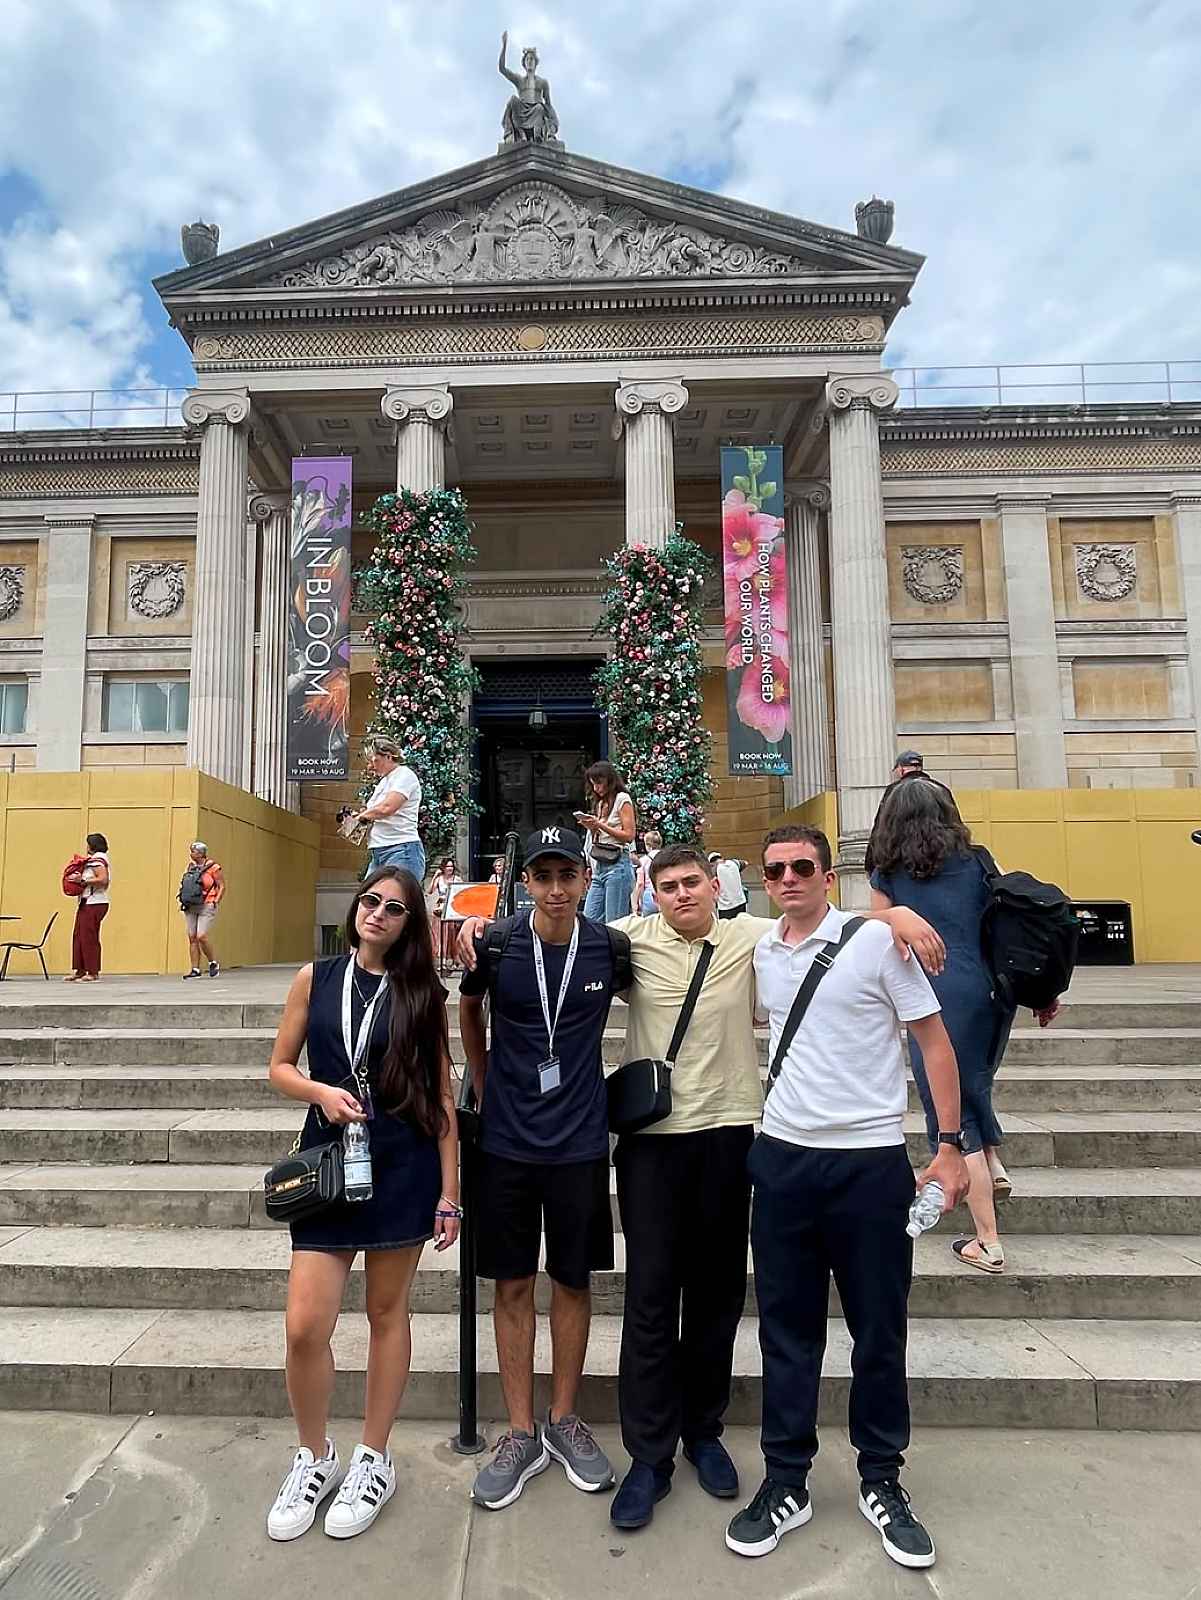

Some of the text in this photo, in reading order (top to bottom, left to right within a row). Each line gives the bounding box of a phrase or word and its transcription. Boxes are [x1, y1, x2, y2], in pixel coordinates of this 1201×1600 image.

[305, 537, 332, 696] IN BLOOM
[739, 580, 754, 664] OUR WORLD
[758, 543, 773, 703] HOW PLANTS CHANGED
[541, 826, 561, 844] NY
